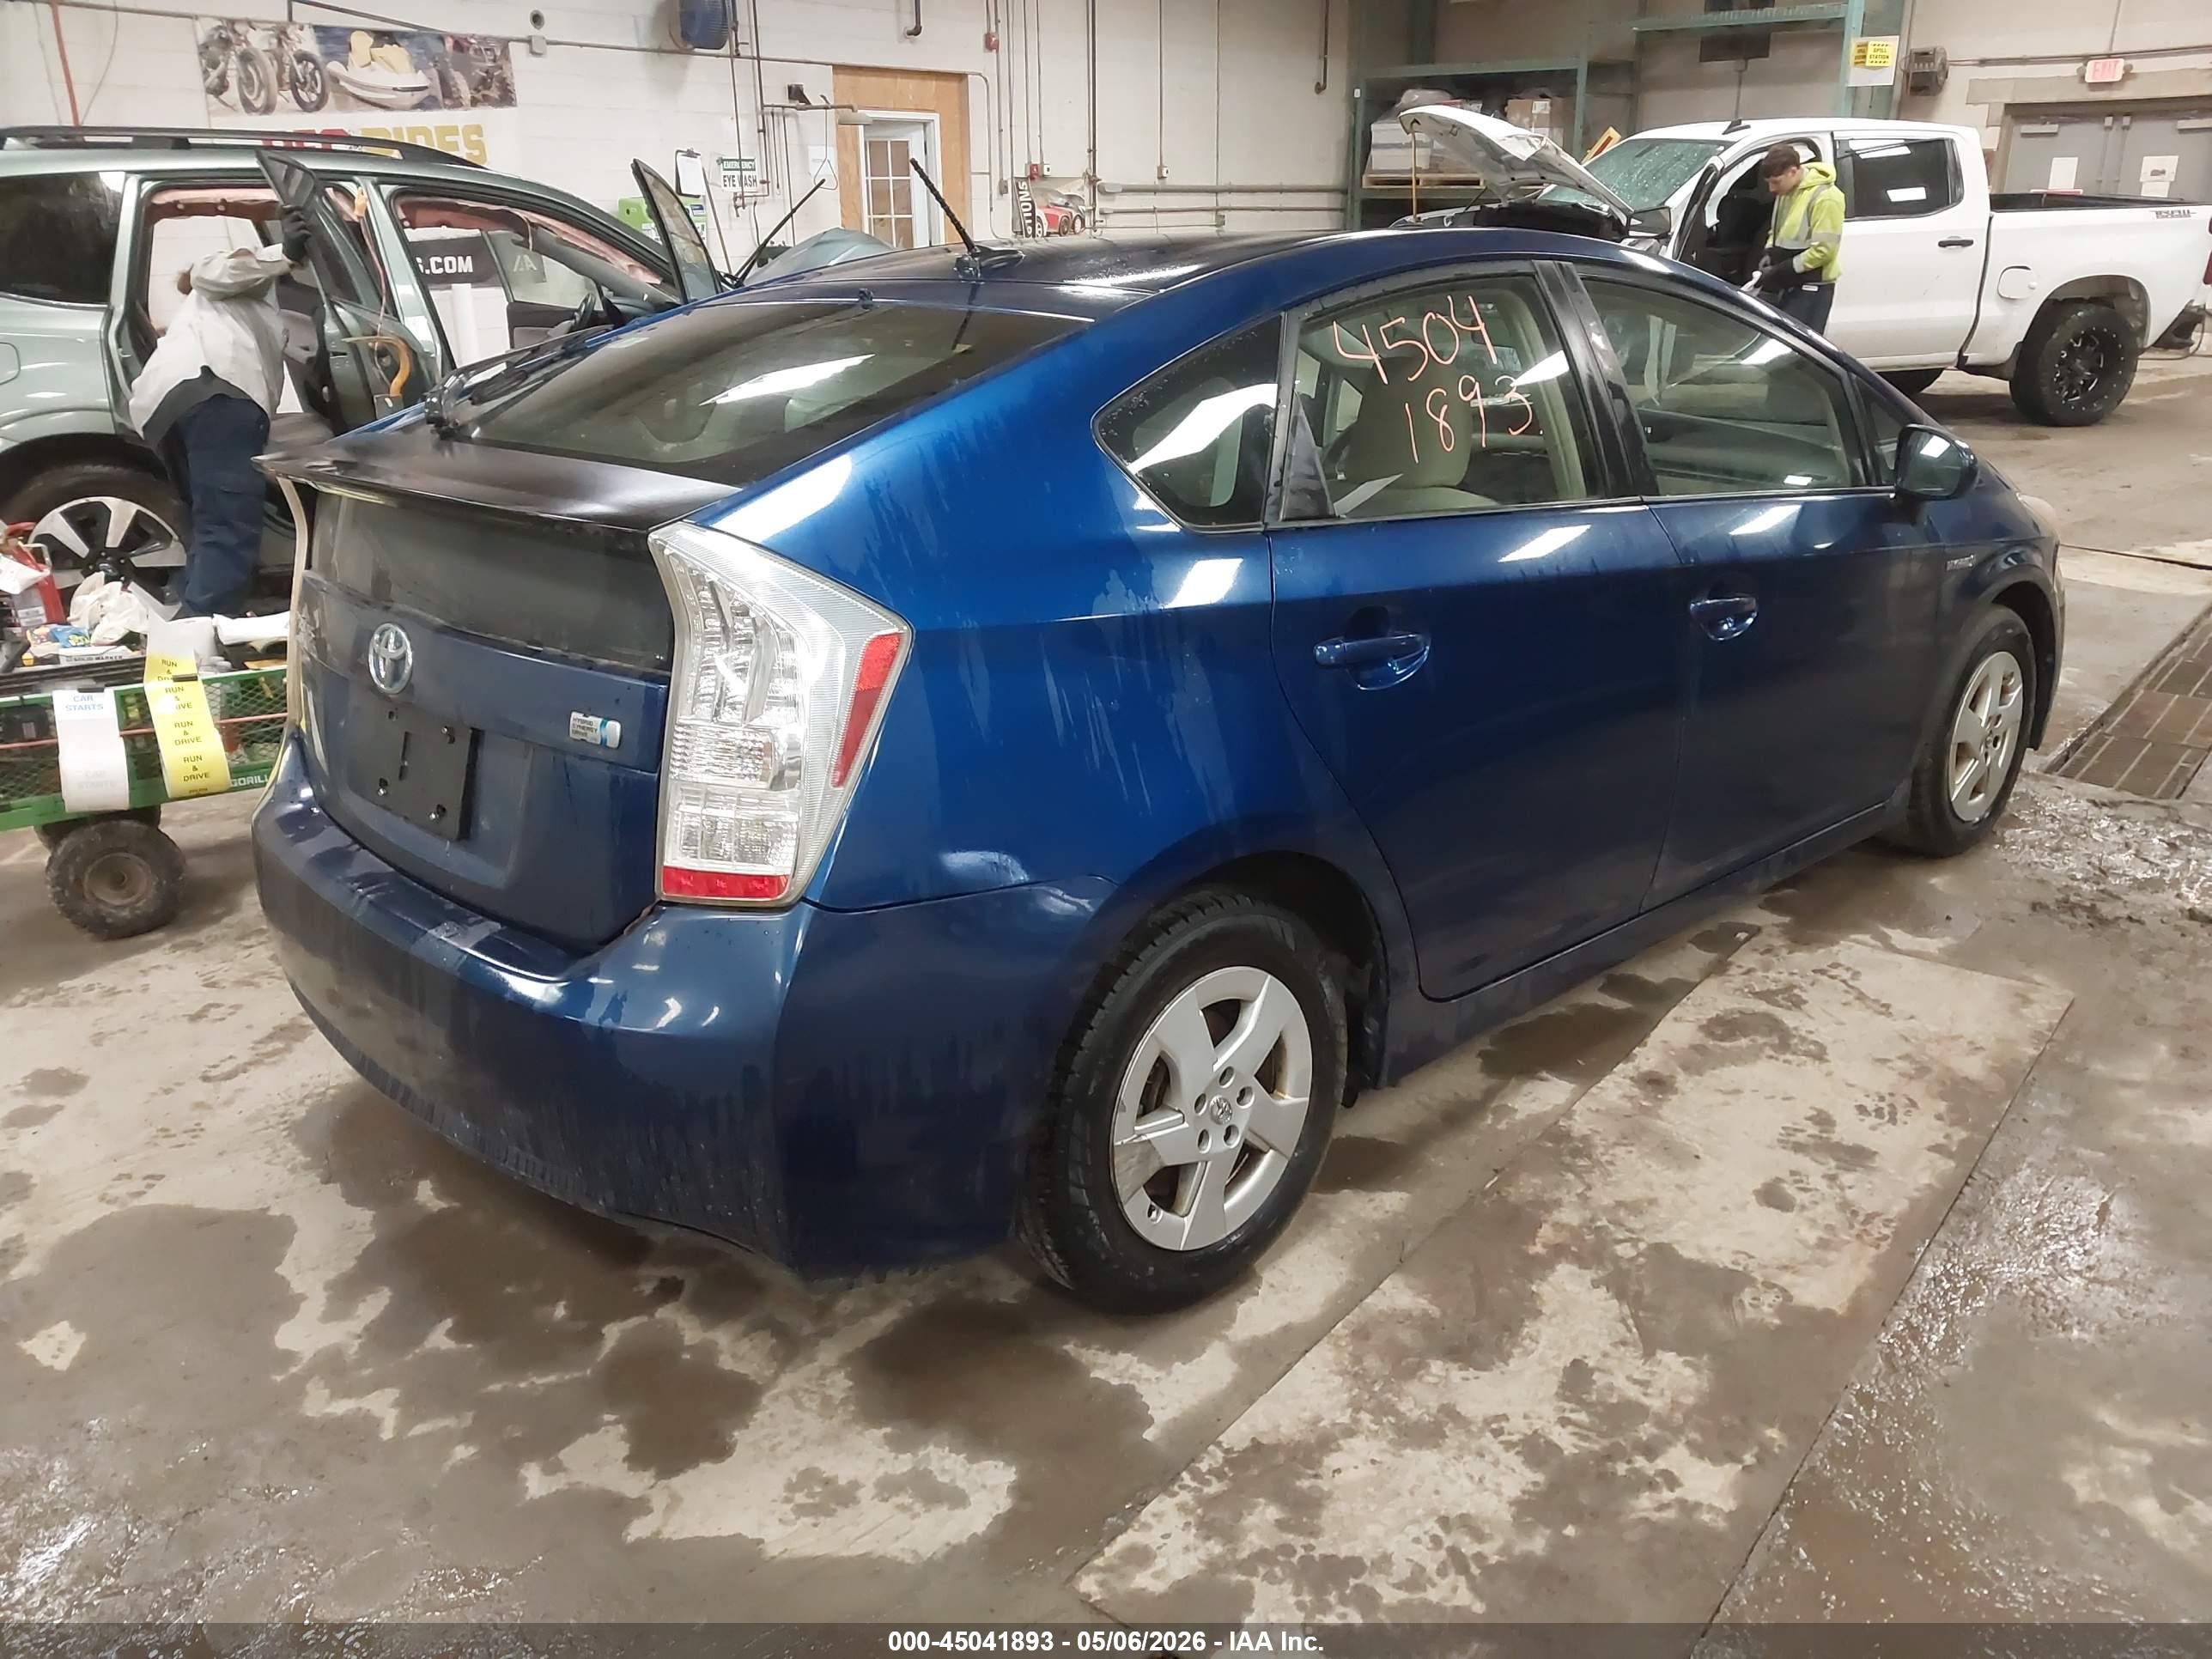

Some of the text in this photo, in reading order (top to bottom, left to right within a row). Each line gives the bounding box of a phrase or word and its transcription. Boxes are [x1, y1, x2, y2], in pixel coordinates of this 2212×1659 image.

[722, 174, 737, 187] EYE
[1333, 295, 1498, 385] 4504
[1405, 374, 1533, 464] 1893
[161, 659, 178, 667] RUN
[65, 703, 104, 712] STARTS
[174, 720, 193, 729] RUN
[174, 736, 203, 746] DRIVE
[183, 755, 203, 763] RUN
[183, 773, 210, 782] DRIVE
